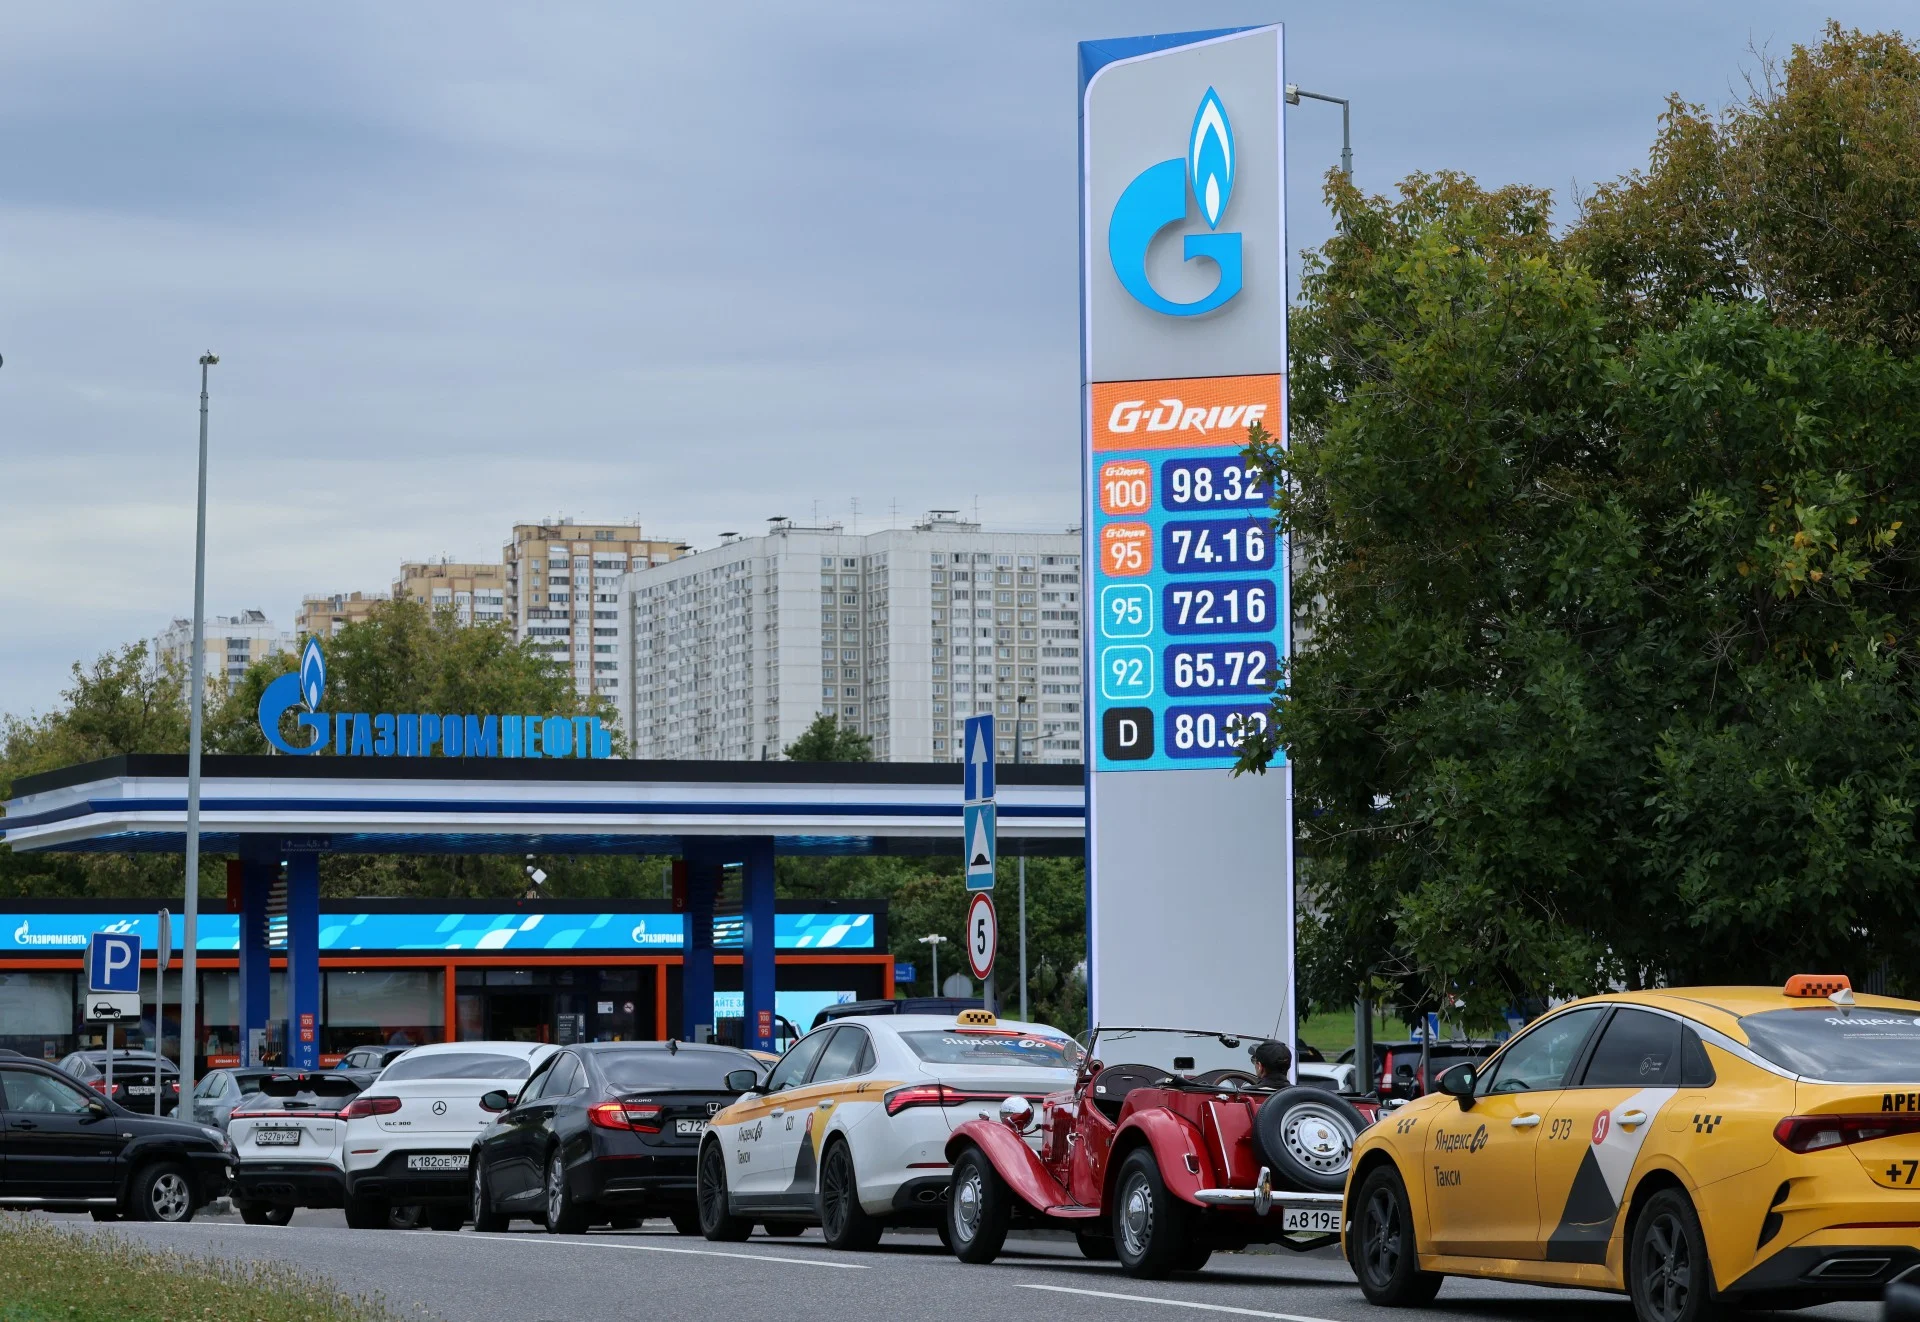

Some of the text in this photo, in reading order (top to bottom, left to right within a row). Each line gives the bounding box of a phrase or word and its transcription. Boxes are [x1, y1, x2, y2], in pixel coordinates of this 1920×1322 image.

[1105, 480, 1146, 508] 100
[1172, 466, 1264, 503] 98.32
[1111, 541, 1142, 569] 95
[1172, 527, 1265, 564] 74.16
[1112, 597, 1143, 625] 95
[1173, 587, 1266, 625] 72.16
[1112, 658, 1143, 686] 92
[1174, 650, 1267, 688] 65.72
[1119, 719, 1138, 747] D
[977, 918, 986, 955] 5
[104, 940, 132, 985] P
[302, 1018, 313, 1026] 100
[303, 1032, 312, 1040] 95
[1824, 1018, 1912, 1026] Яндекс
[303, 1045, 312, 1053] 95
[942, 1038, 1015, 1047] Яндекс
[1881, 1093, 1920, 1112] АРЕ
[1435, 1129, 1472, 1153] Яндекс
[1549, 1119, 1573, 1140] 973
[1434, 1166, 1461, 1187] Такси
[1886, 1160, 1919, 1185] +7
